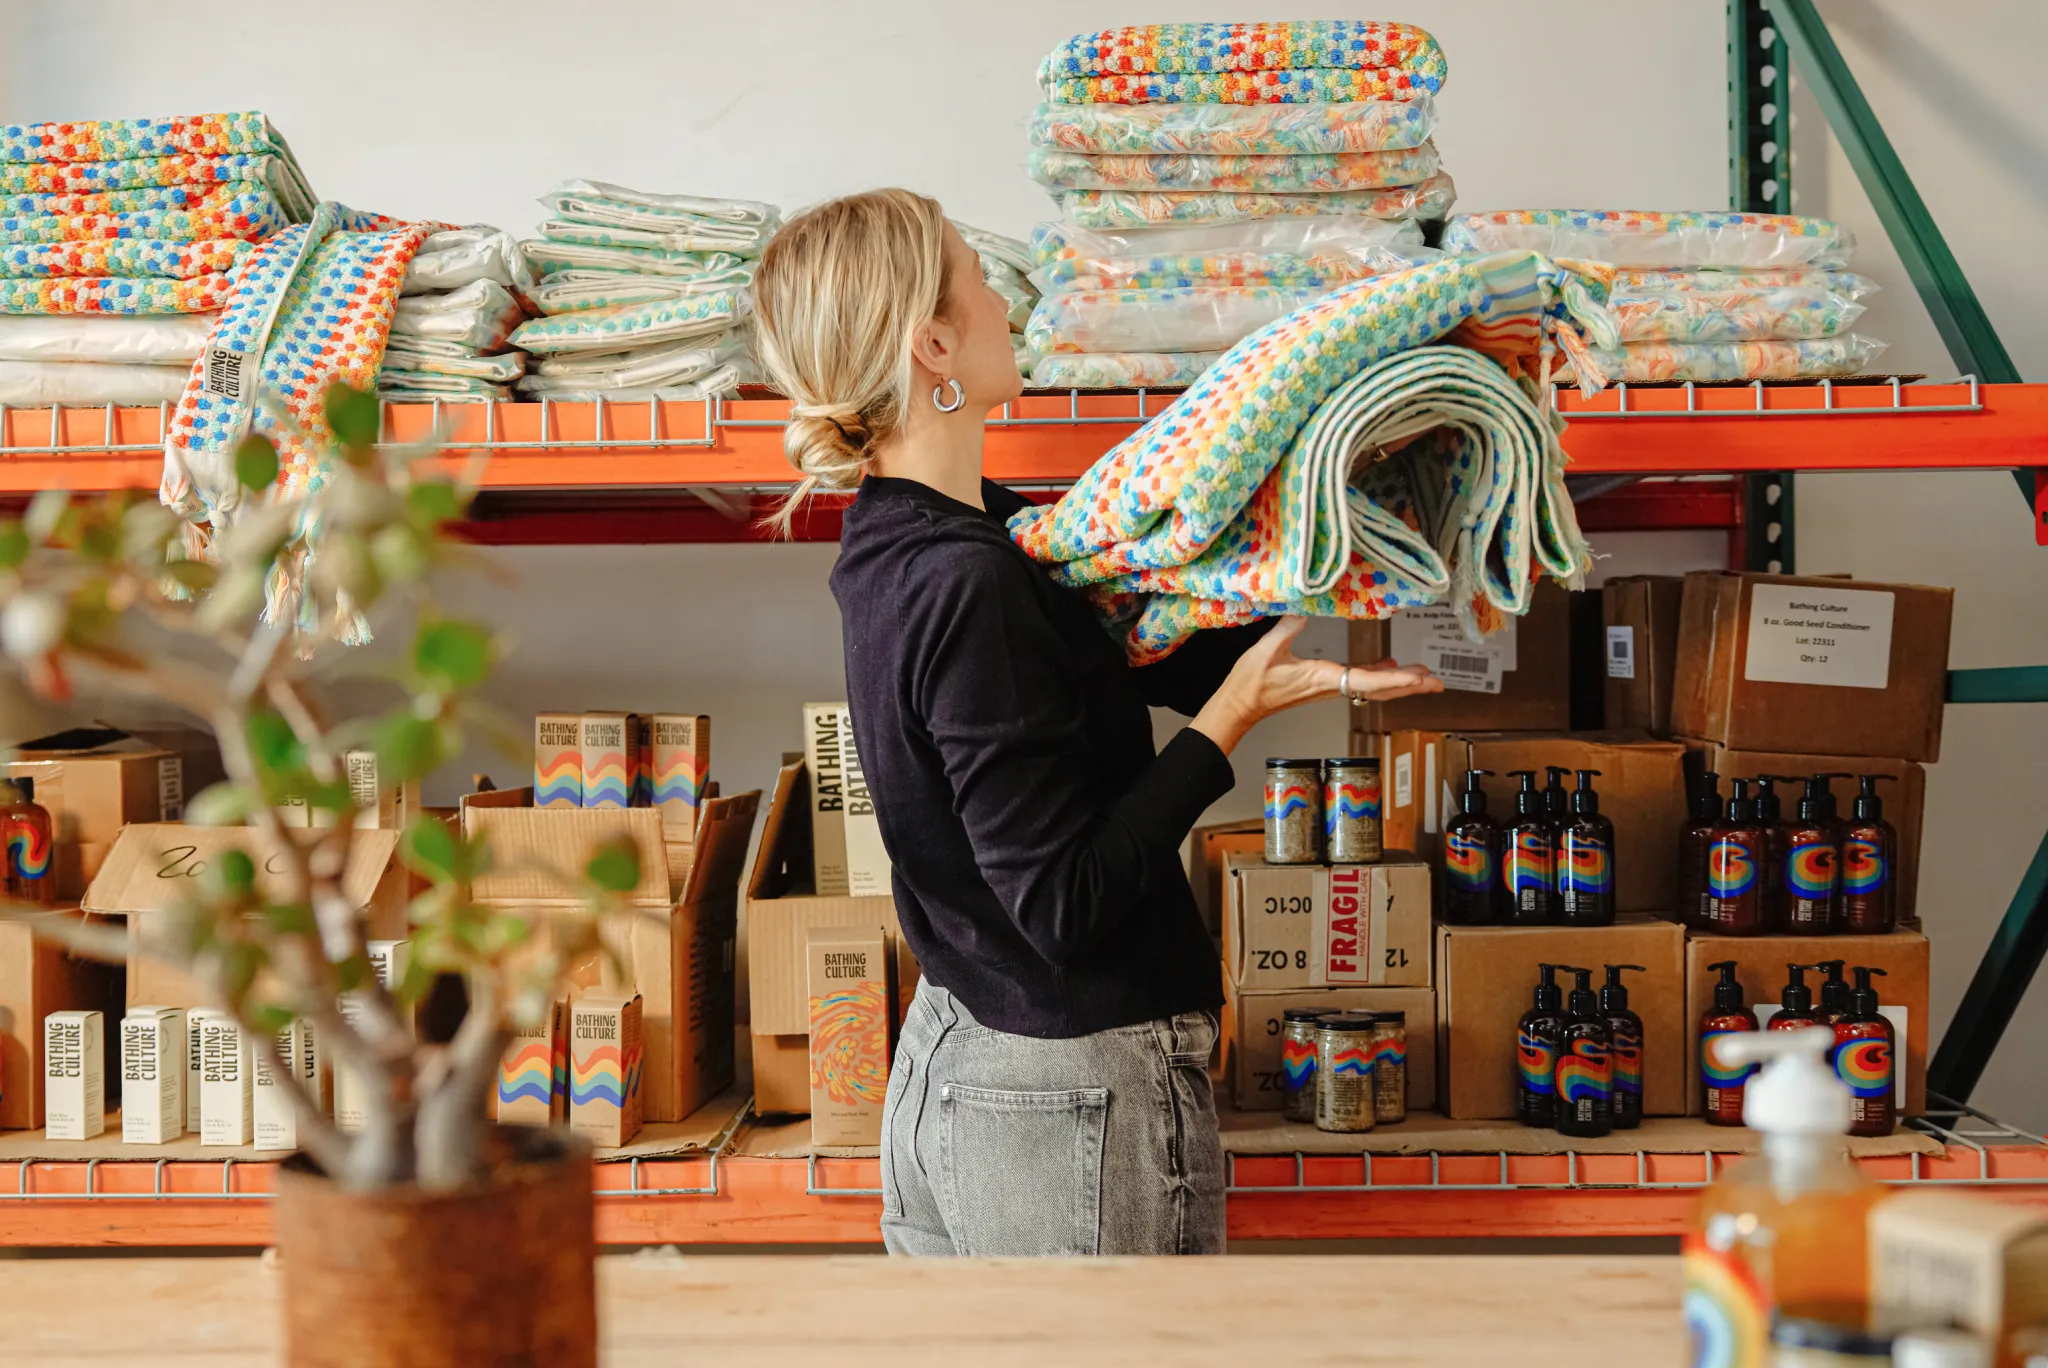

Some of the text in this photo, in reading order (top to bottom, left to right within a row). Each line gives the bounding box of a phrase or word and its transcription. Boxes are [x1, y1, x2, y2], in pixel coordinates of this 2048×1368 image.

[210, 350, 227, 394] BATHING
[225, 352, 243, 397] CULTURE
[1789, 602, 1848, 613] Bathing Culture
[1783, 618, 1804, 627] Good
[1806, 620, 1824, 628] Seed
[1826, 621, 1871, 632] Conditioner
[1819, 655, 1828, 663] 12
[540, 723, 577, 734] BATHING
[584, 724, 621, 735] BATHING
[656, 722, 691, 734] BATHING
[540, 734, 577, 746] CULTURE
[585, 735, 620, 747] CULTURE
[656, 734, 690, 746] CULTURE
[815, 714, 844, 812] BATHING
[1360, 869, 1368, 893] CARE
[1359, 922, 1367, 957] HANDLE
[825, 953, 866, 966] BATHING
[1251, 950, 1288, 969] OZ.
[1295, 950, 1307, 969] 8
[825, 965, 866, 978] CULTURE
[576, 1014, 616, 1027] BATHING
[576, 1027, 616, 1040] CULTURE
[49, 1022, 64, 1078] BATHING
[65, 1023, 80, 1078] CULTURE
[125, 1025, 140, 1081] BATHING
[141, 1026, 156, 1081] CULTURE
[204, 1026, 221, 1082] BATHING
[221, 1027, 238, 1082] CULTURE
